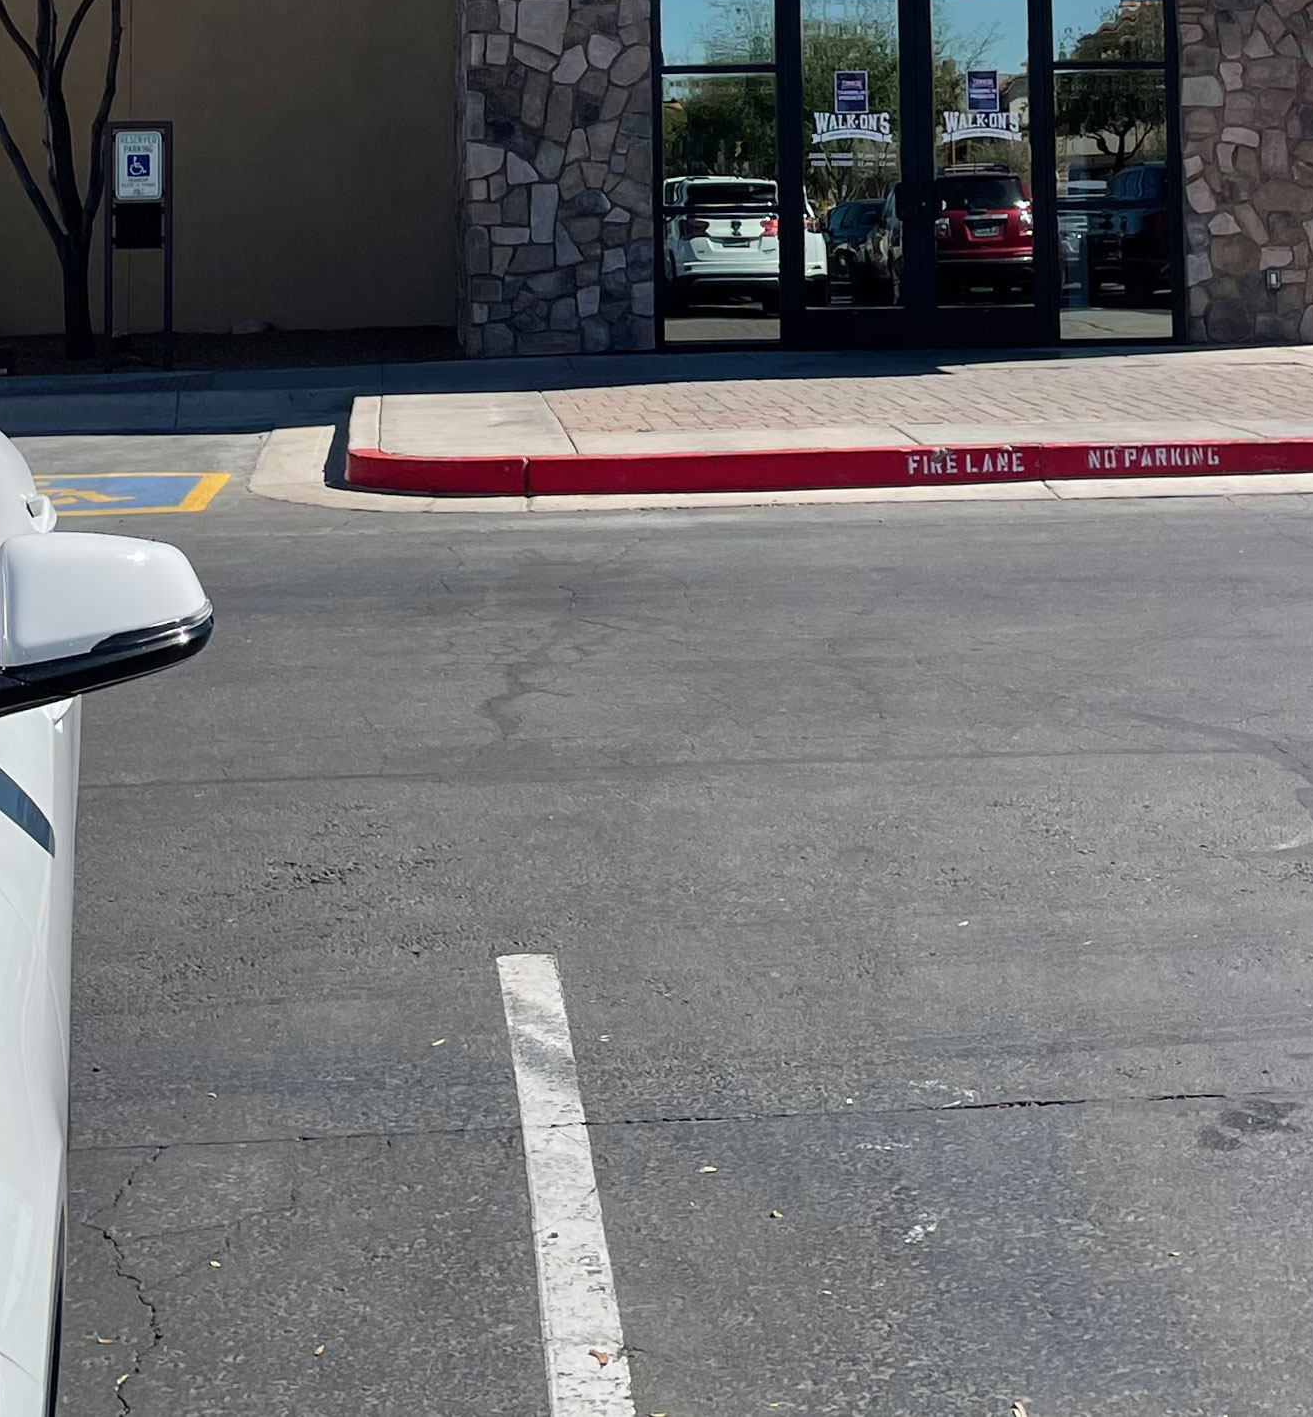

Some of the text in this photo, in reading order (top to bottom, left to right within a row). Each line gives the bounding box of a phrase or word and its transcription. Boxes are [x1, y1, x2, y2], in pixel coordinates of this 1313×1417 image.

[120, 134, 157, 144] RESERVED
[123, 144, 154, 153] PARKING
[965, 452, 1025, 474] LANE
[1087, 448, 1117, 469] NO
[1123, 446, 1220, 467] PARKING
